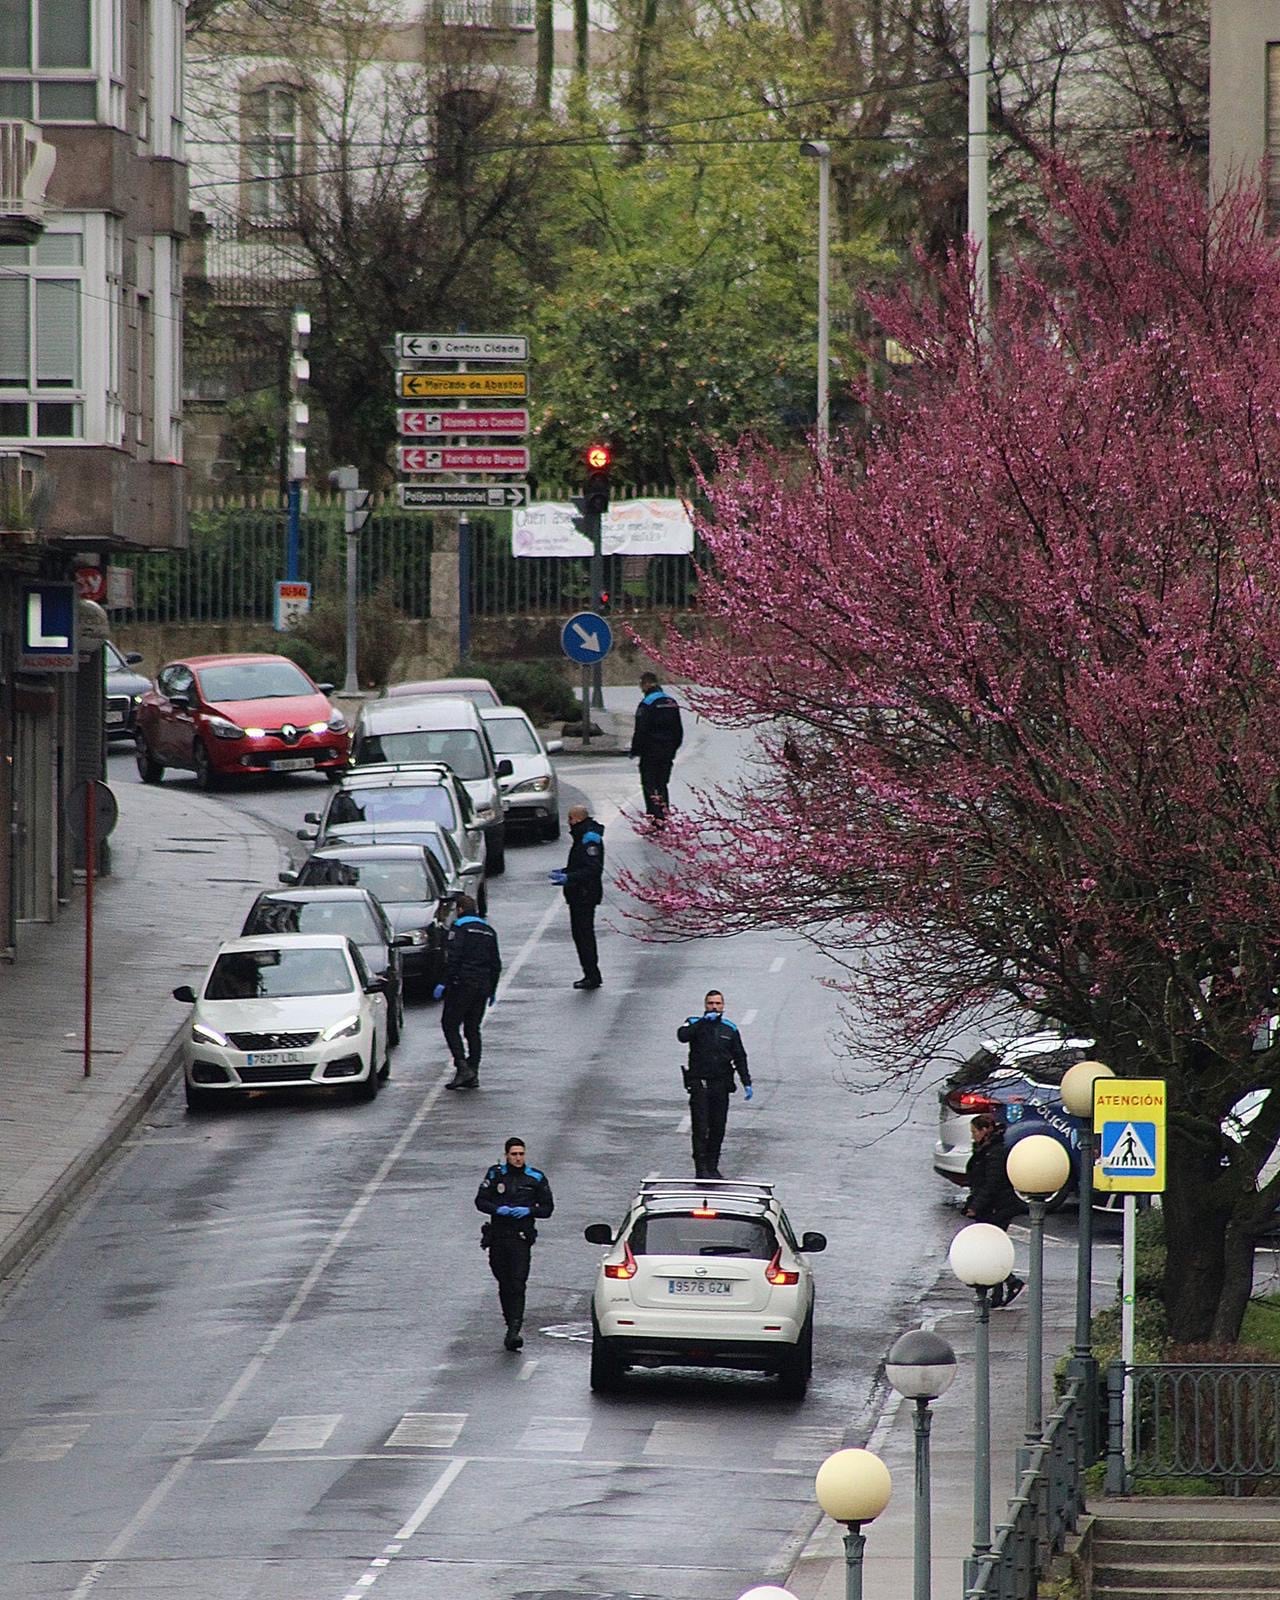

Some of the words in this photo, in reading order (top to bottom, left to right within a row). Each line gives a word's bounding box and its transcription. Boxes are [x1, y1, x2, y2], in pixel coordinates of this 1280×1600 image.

[445, 343, 481, 353] Centro
[484, 344, 520, 354] Cidade
[425, 381, 465, 390] Mercado
[469, 381, 481, 390] de
[485, 380, 524, 390] Abastos
[28, 593, 68, 648] L
[1096, 1094, 1163, 1106] ATENCIÓN
[676, 1281, 705, 1292] 9576
